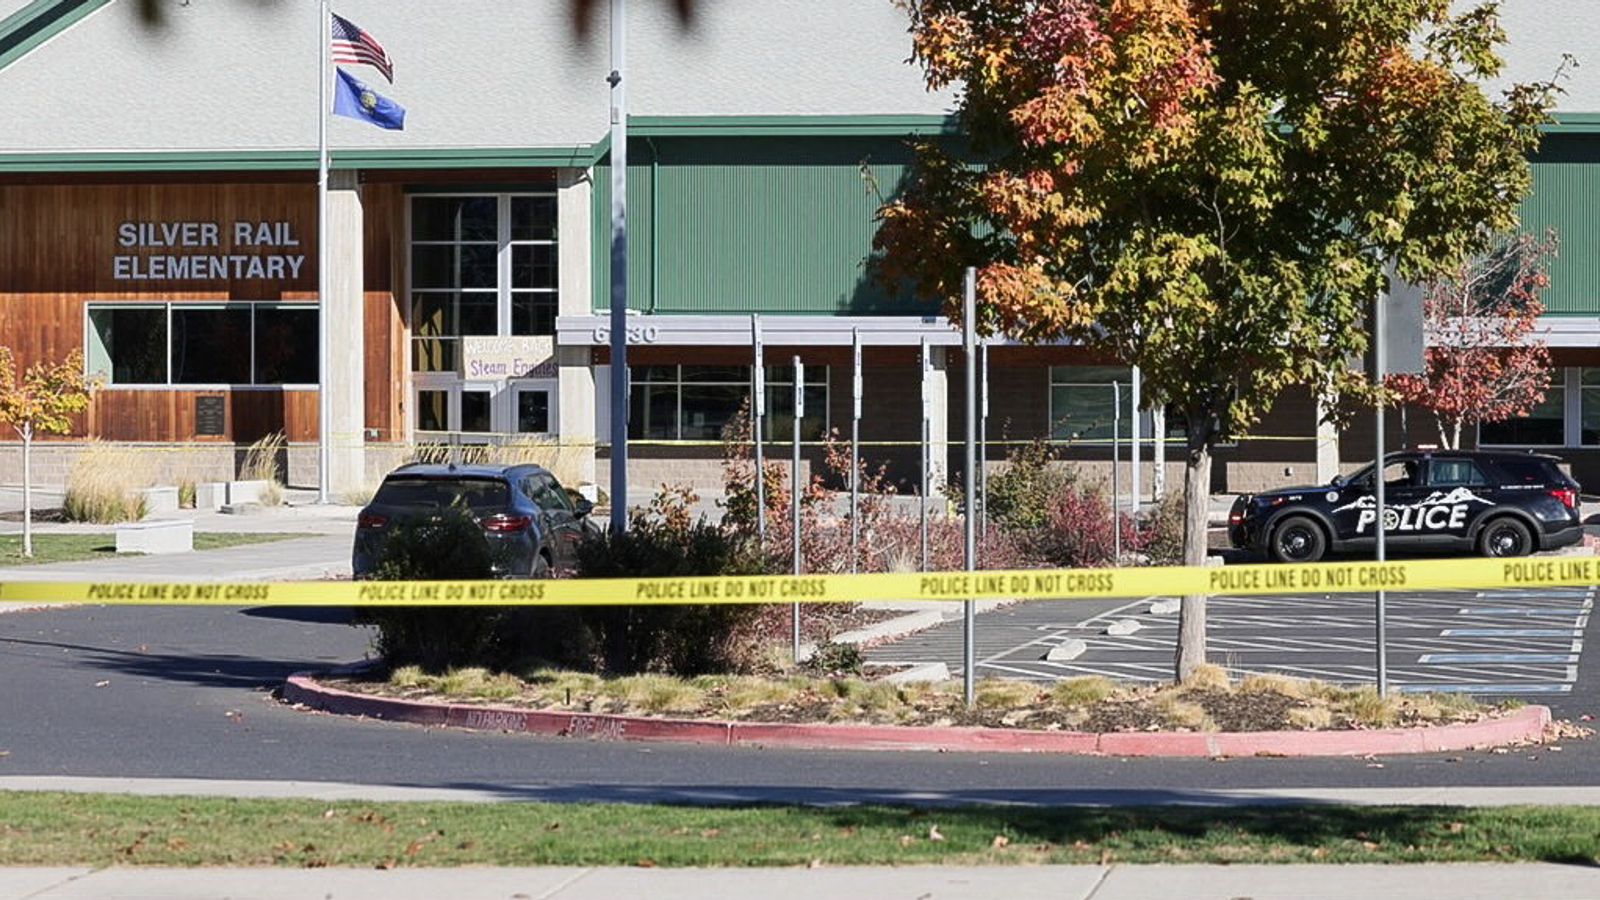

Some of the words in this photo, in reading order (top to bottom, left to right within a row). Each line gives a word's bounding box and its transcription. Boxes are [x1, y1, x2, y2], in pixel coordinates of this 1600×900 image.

[119, 222, 219, 247] SILVER
[235, 222, 300, 246] RAIL
[113, 255, 305, 280] ELEMENTARY
[593, 327, 657, 343] 630
[471, 359, 507, 377] Steam
[1356, 504, 1468, 533] POLICE
[1210, 571, 1260, 590] POLICE
[1265, 570, 1296, 589] LINE
[1301, 569, 1320, 588] DO
[1326, 568, 1352, 587] NOT
[1358, 566, 1406, 586] CROSS
[1503, 562, 1555, 582] POLICE
[1560, 561, 1591, 580] LINE
[87, 585, 133, 600] POLICE
[139, 584, 167, 599] LINE
[172, 584, 191, 599] DO
[197, 584, 220, 599] NOT
[224, 584, 269, 600] CROSS
[358, 584, 406, 600] POLICE
[411, 584, 439, 600] LINE
[445, 584, 464, 600] DO
[469, 584, 494, 600] NOT
[499, 583, 545, 600] CROSS
[636, 582, 685, 599] POLICE
[690, 582, 719, 598] LINE
[725, 581, 744, 598] DO
[749, 581, 775, 597] NOT
[780, 579, 826, 597] CROSS
[920, 577, 969, 595] POLICE
[974, 576, 1004, 594] LINE
[1011, 575, 1029, 593] DO
[1035, 574, 1061, 593] NOT
[1067, 573, 1114, 592] CROSS
